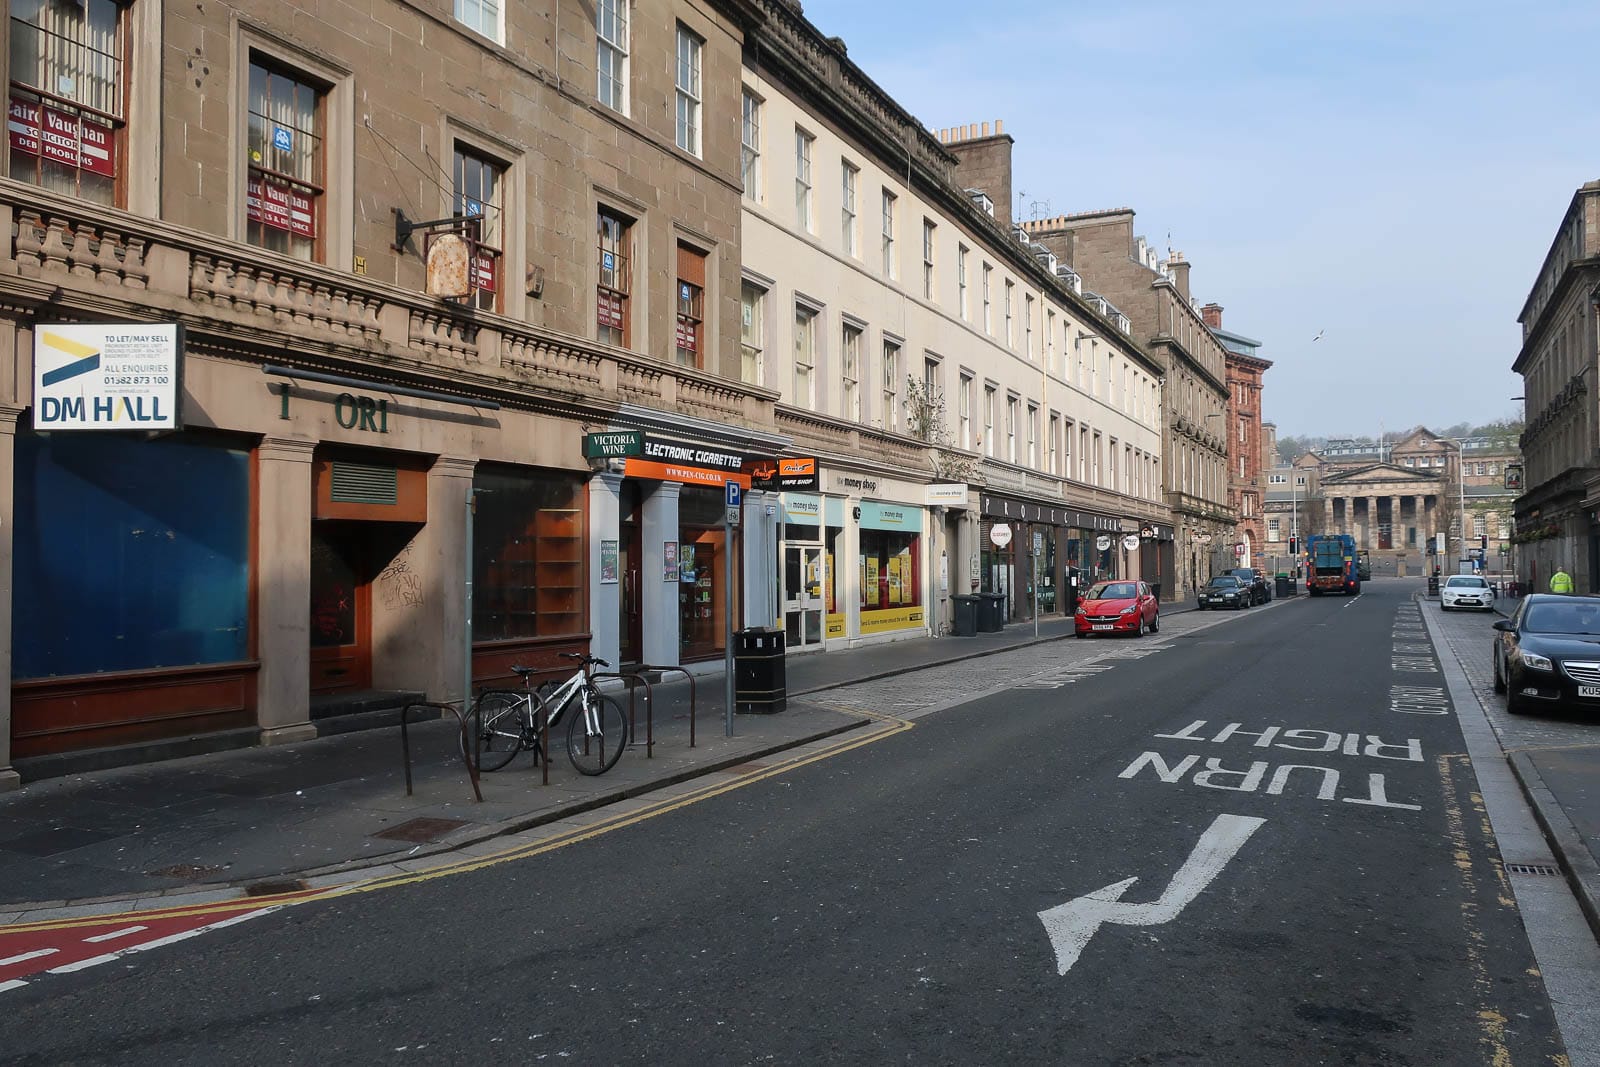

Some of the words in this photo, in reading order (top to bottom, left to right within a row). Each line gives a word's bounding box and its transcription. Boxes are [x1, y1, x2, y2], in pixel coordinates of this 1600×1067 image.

[19, 138, 38, 150] DEB
[105, 335, 115, 343] TO
[117, 335, 150, 344] LET/MAY
[151, 335, 168, 343] SELL
[105, 365, 120, 373] ALL
[122, 365, 168, 374] ENQUIRIES
[133, 376, 150, 385] 873
[153, 376, 168, 385] 100
[41, 397, 86, 422] DM
[94, 396, 168, 423] HALL
[594, 435, 635, 445] VICTORIA
[602, 445, 626, 455] WINE
[845, 477, 862, 491] money
[863, 478, 877, 493] shop
[729, 484, 739, 504] P
[793, 502, 807, 511] money
[808, 501, 818, 512] shop
[1153, 720, 1424, 762] RIGHT
[1117, 751, 1422, 811] TURN
